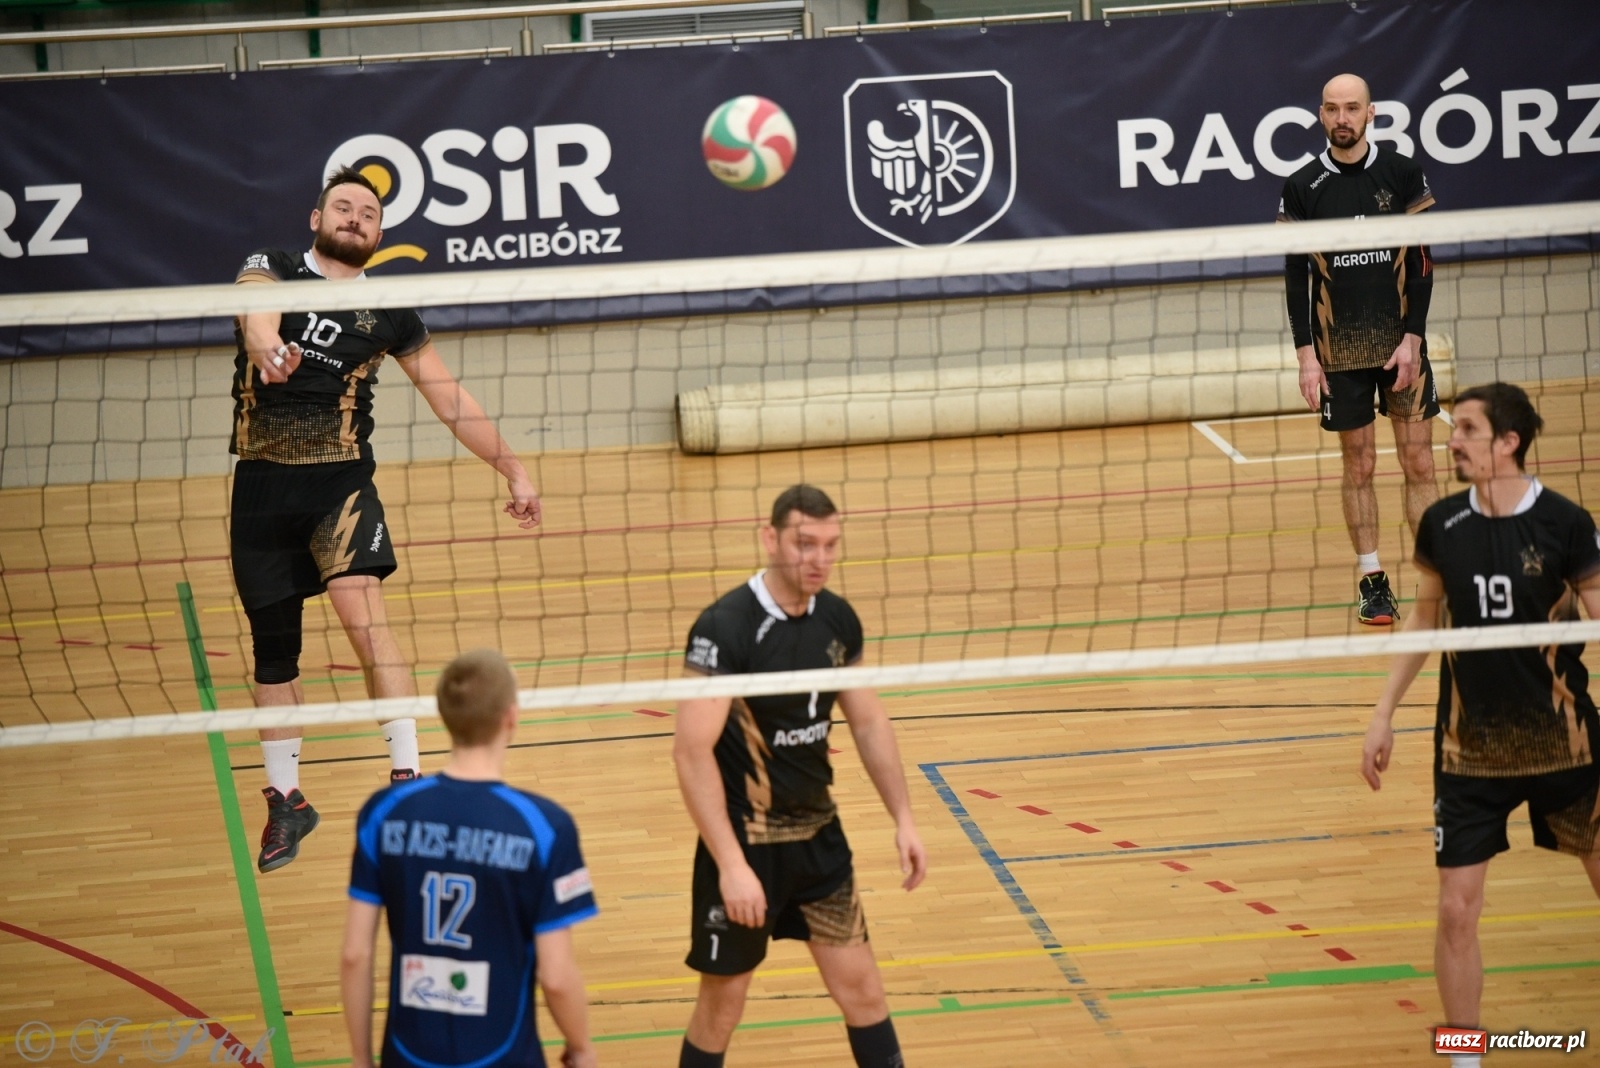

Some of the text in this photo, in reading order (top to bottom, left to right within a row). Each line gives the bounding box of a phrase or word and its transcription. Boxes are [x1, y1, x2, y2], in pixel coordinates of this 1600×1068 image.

[1117, 67, 1600, 189] RACBÓRZ
[446, 221, 624, 264] RACIBÓRZ
[1332, 249, 1392, 268] AGROTIM
[301, 311, 343, 348] 10
[1323, 401, 1332, 421] 4
[1473, 573, 1514, 619] 19
[420, 870, 477, 950] 12
[709, 933, 720, 962] 1
